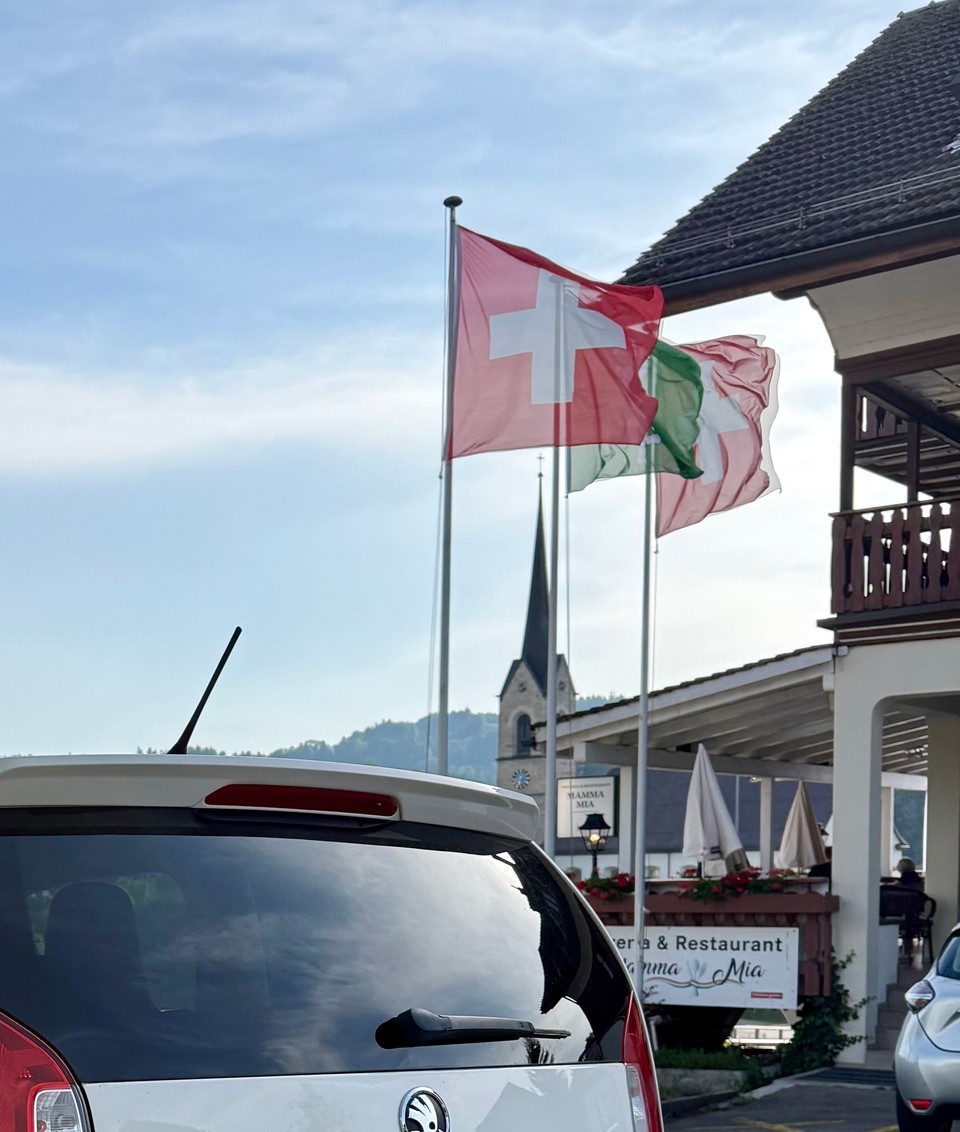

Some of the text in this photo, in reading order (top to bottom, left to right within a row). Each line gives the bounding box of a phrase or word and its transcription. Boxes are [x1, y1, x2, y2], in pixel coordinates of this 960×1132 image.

[567, 791, 605, 801] MAMMA
[576, 800, 595, 809] MIA
[657, 935, 669, 951] &
[676, 935, 784, 952] Restaurant
[712, 957, 766, 986] Mia
